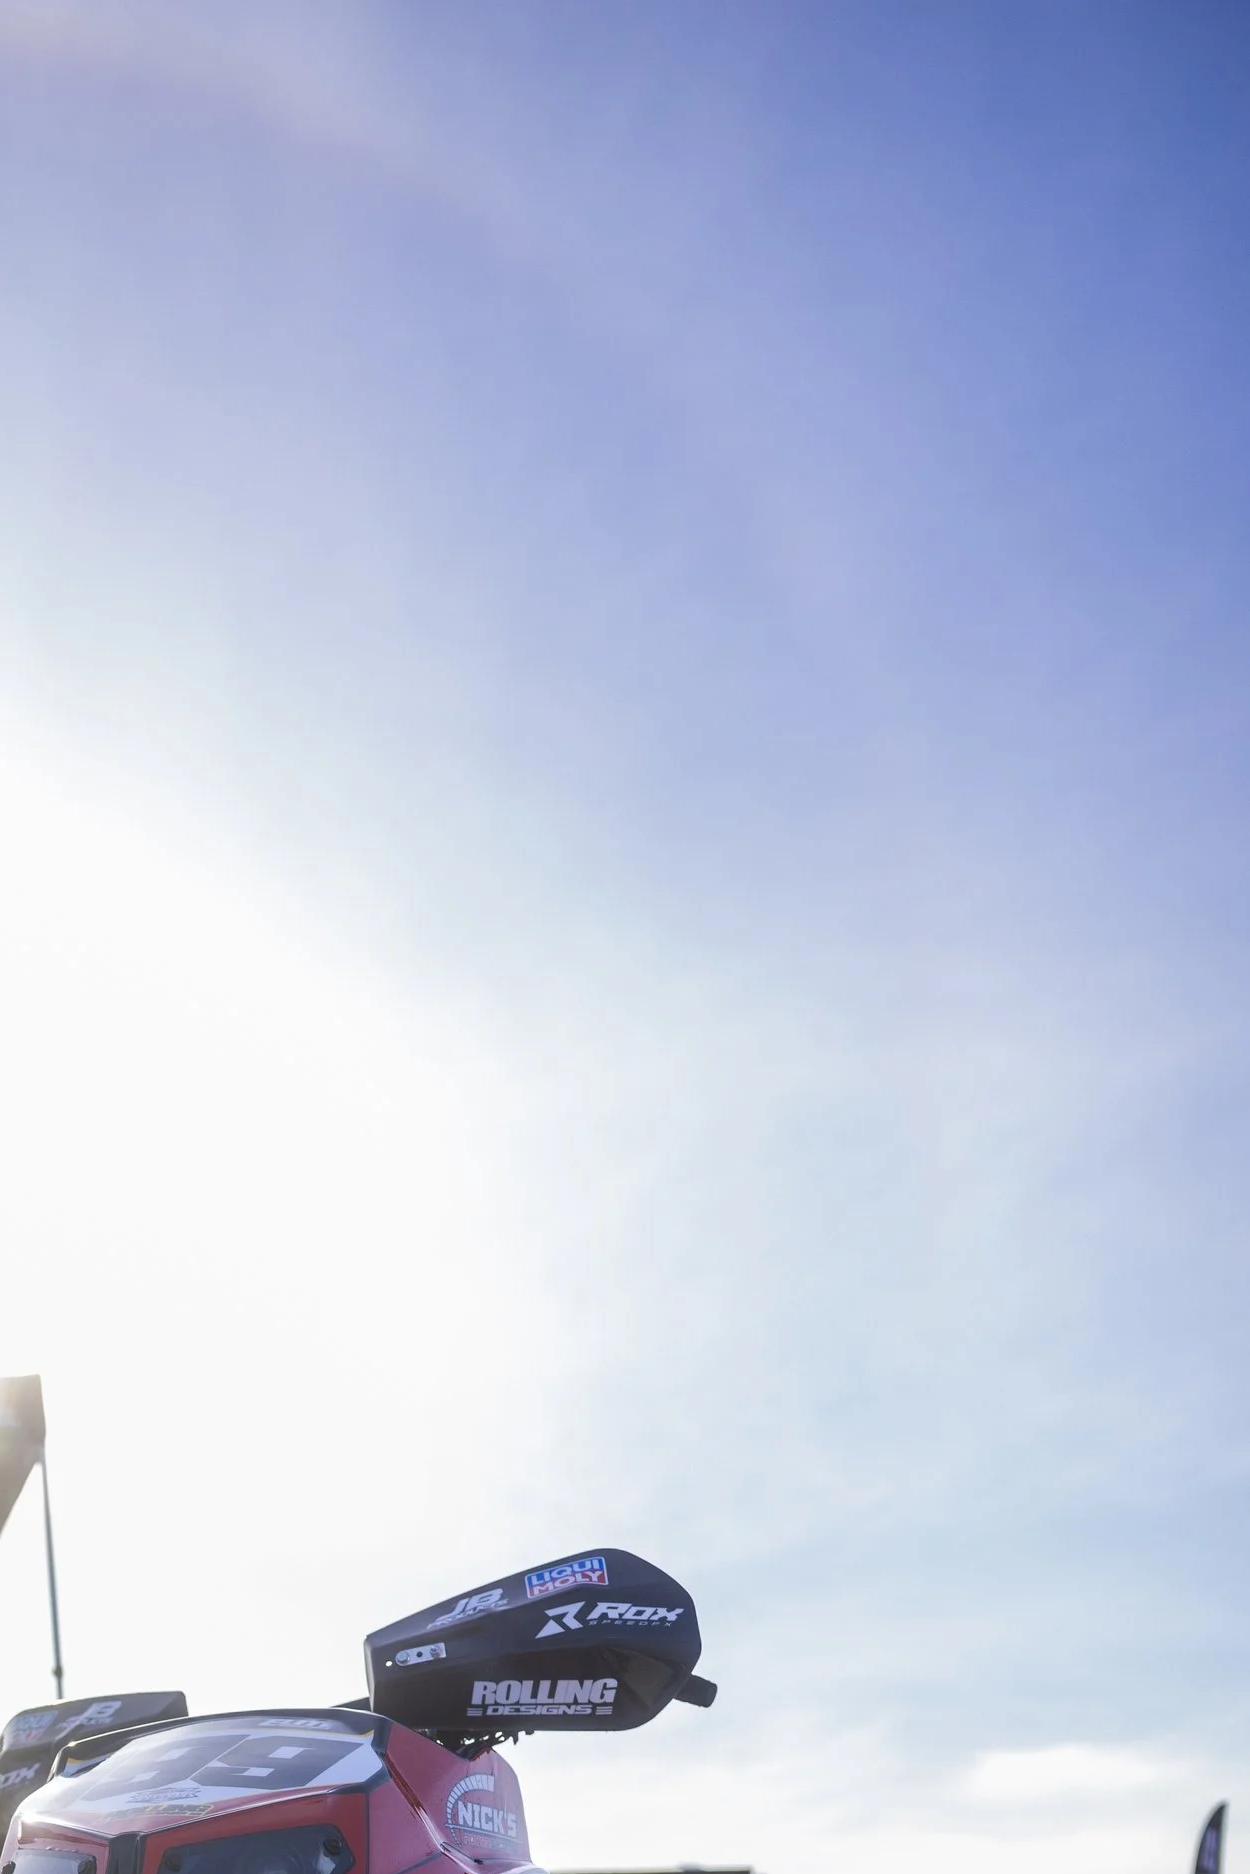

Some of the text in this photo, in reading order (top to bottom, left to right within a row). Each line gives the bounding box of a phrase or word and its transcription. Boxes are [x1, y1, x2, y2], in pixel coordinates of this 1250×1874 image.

[530, 1558, 601, 1585] LIQUI
[533, 1570, 604, 1596] MOLY
[470, 1677, 619, 1706] ROLLING
[485, 1703, 593, 1716] DESIGNS
[457, 1799, 517, 1838] NICK'S
